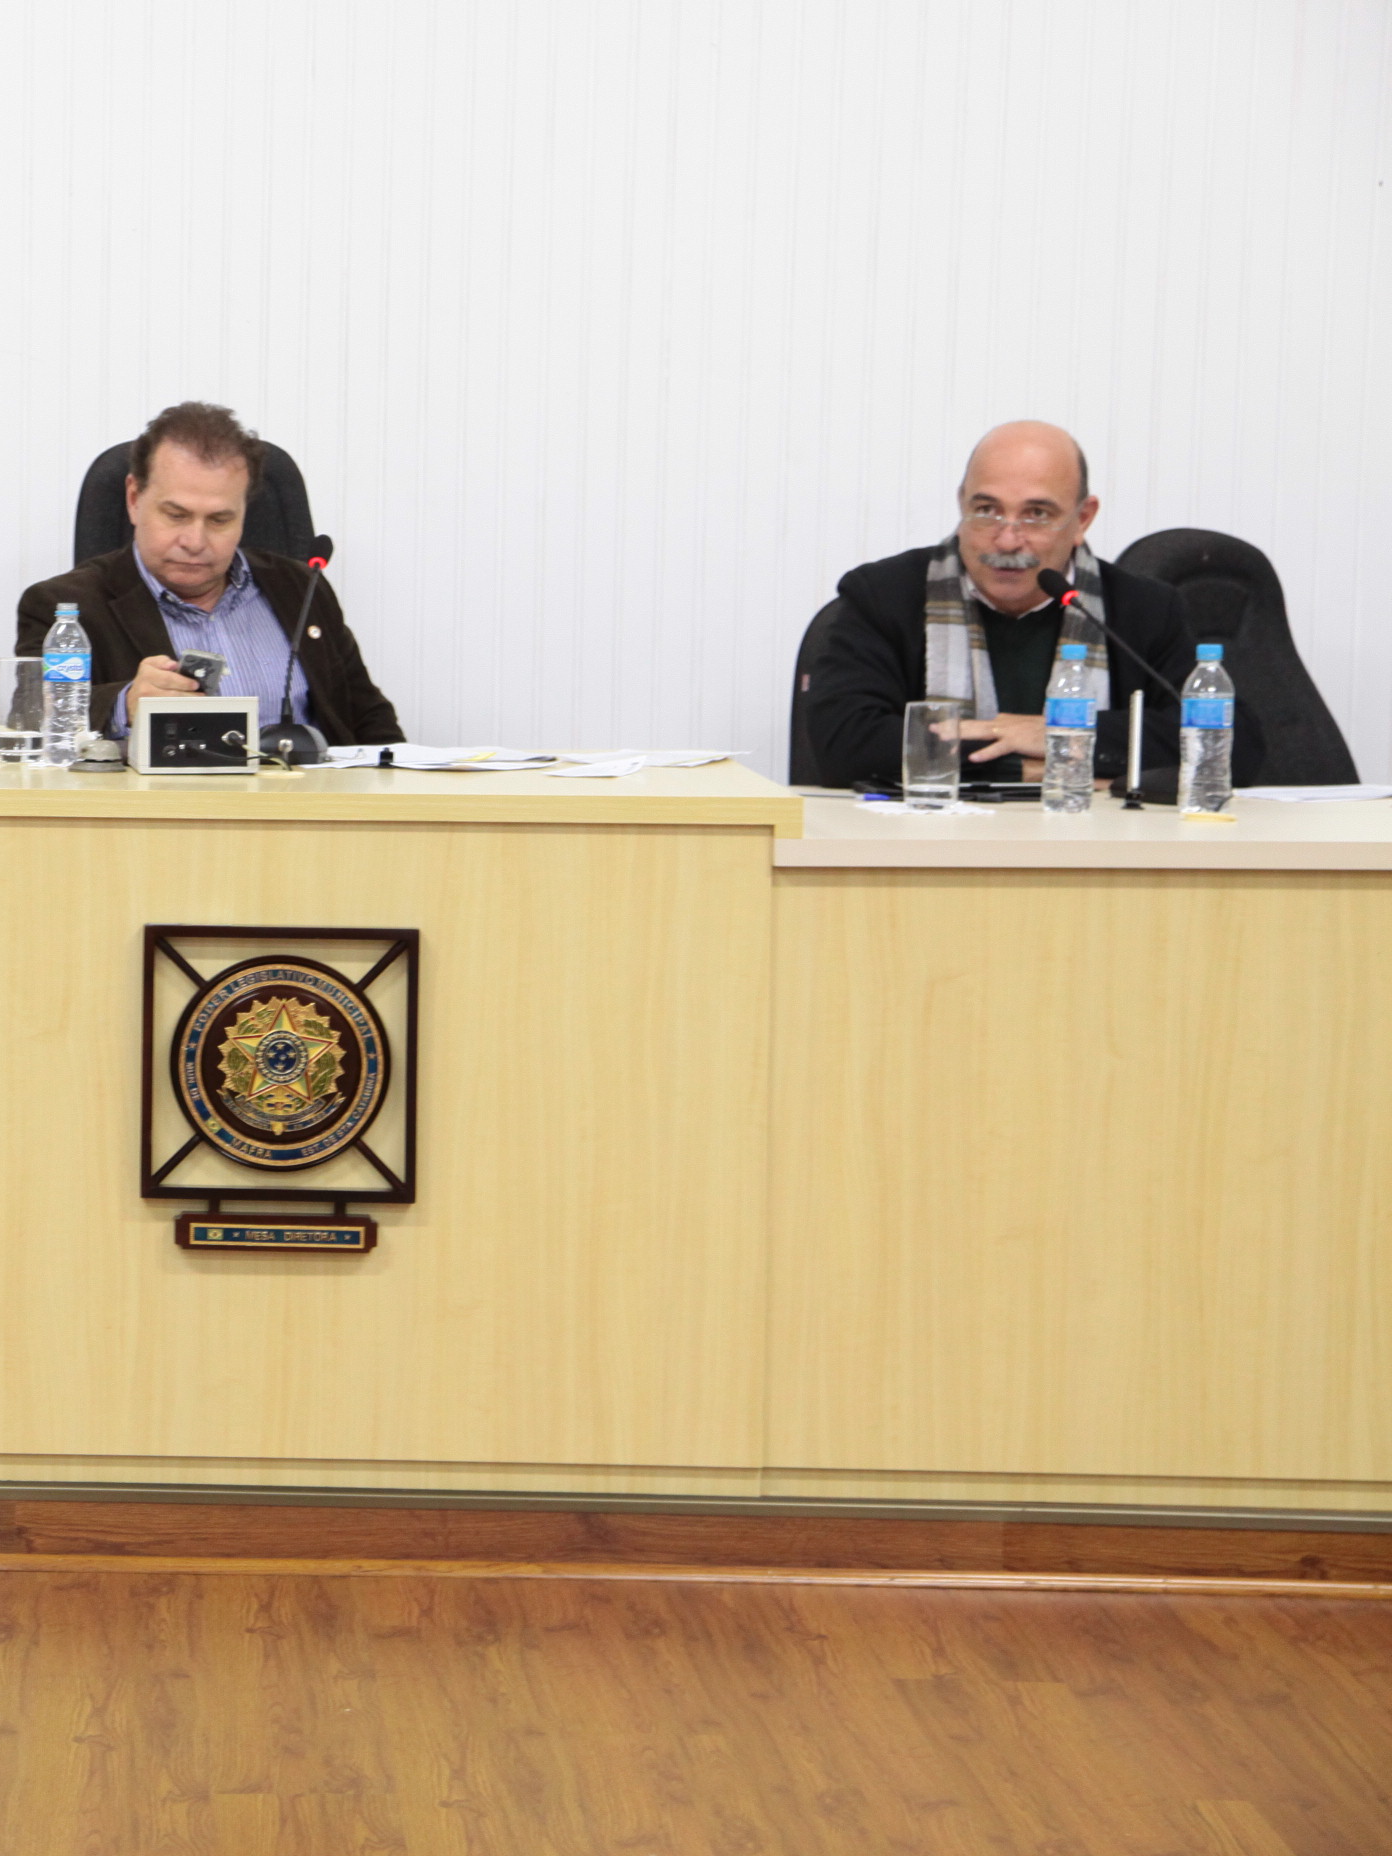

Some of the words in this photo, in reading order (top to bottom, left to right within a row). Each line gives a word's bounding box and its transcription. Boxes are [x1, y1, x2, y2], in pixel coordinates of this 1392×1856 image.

[195, 988, 228, 1032] PODER
[230, 969, 315, 993] LEGISLATIVO
[317, 979, 374, 1038] MUNICIPAL
[229, 1136, 273, 1159] MAFRA
[245, 1230, 275, 1241] MESA
[283, 1231, 337, 1242] DIRETORA
